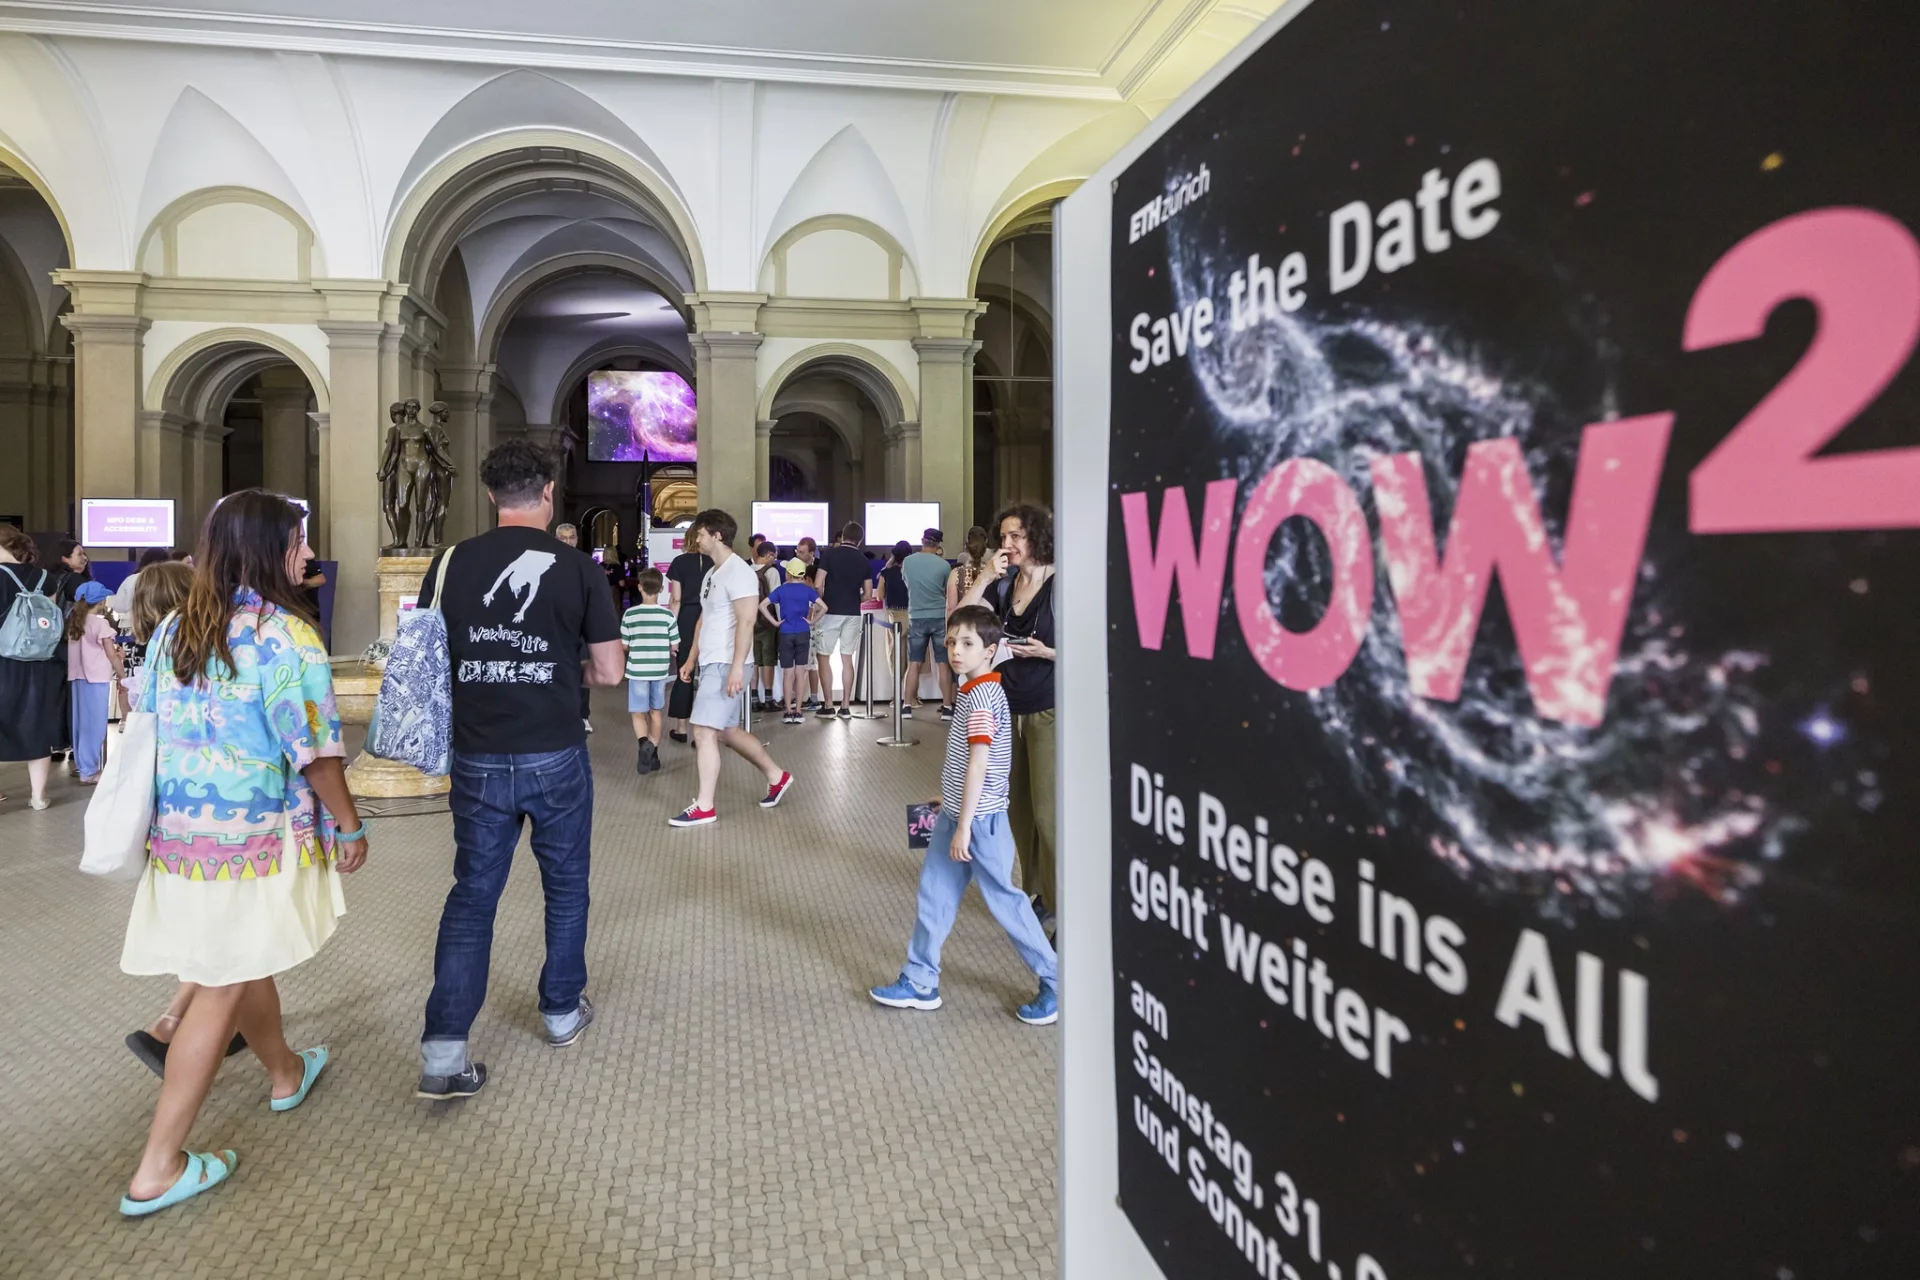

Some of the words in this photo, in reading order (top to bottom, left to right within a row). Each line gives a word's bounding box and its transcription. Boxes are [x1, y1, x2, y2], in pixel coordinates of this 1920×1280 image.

[1129, 296, 1215, 375] Save
[1227, 250, 1308, 332] the
[1329, 157, 1502, 295] Date
[468, 623, 523, 648] Waking
[521, 635, 549, 654] Life
[1129, 857, 1209, 951] geht
[1220, 911, 1411, 1079] weiter
[1130, 762, 1185, 846] Die
[1198, 790, 1335, 924] Reise
[1358, 859, 1468, 996] ins
[1495, 927, 1659, 1103] All
[1130, 979, 1169, 1041] am
[1132, 1029, 1264, 1209] Samstag,
[1134, 1093, 1180, 1175] und
